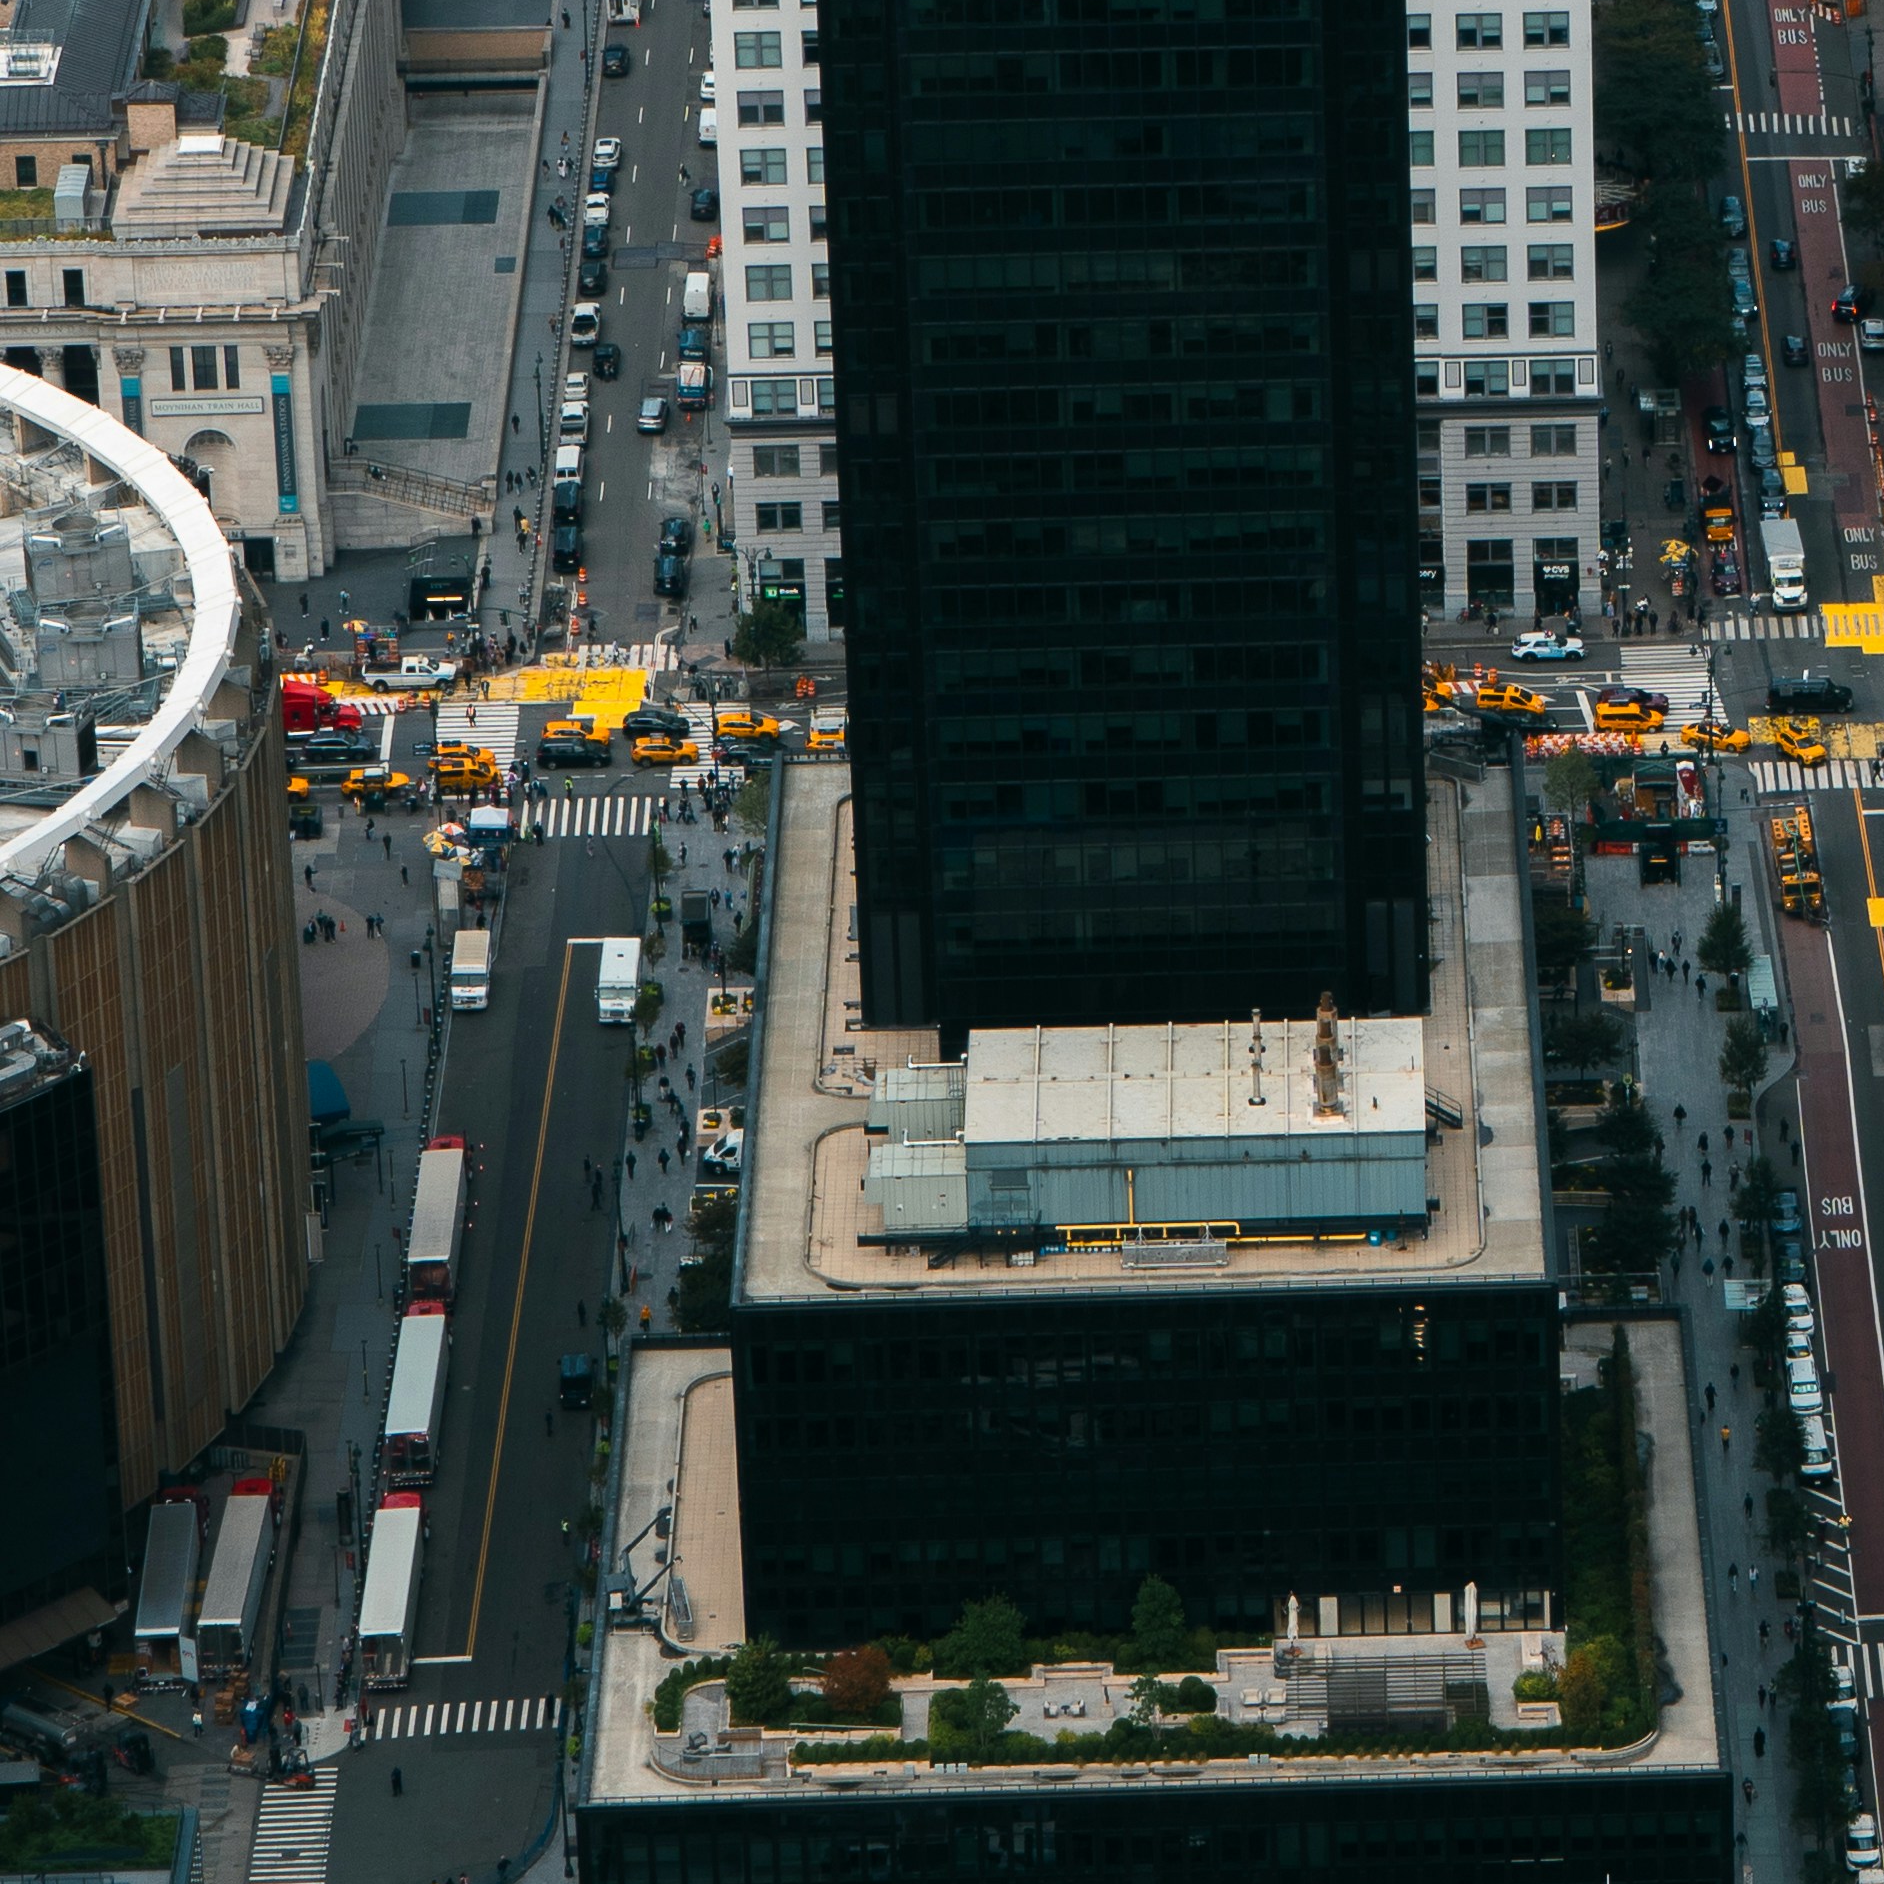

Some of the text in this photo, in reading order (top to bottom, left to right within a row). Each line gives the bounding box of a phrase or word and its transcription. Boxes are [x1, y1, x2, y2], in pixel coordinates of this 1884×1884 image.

[1774, 7, 1806, 23] ONLY
[1777, 29, 1808, 45] BUS
[1798, 173, 1827, 189] ONLY
[1801, 199, 1827, 213] BUS
[1817, 342, 1852, 358] ONLY
[1822, 367, 1853, 383] BUS
[155, 401, 260, 413] MOYNIHAN TRAIN HALL
[278, 397, 292, 492] PENNSYLVANIA STATION
[1844, 527, 1875, 543] ONLY
[1551, 565, 1570, 574] CVS
[1850, 553, 1877, 570] BUS
[1821, 1196, 1854, 1215] BUS
[1820, 1229, 1862, 1249] ONLY
